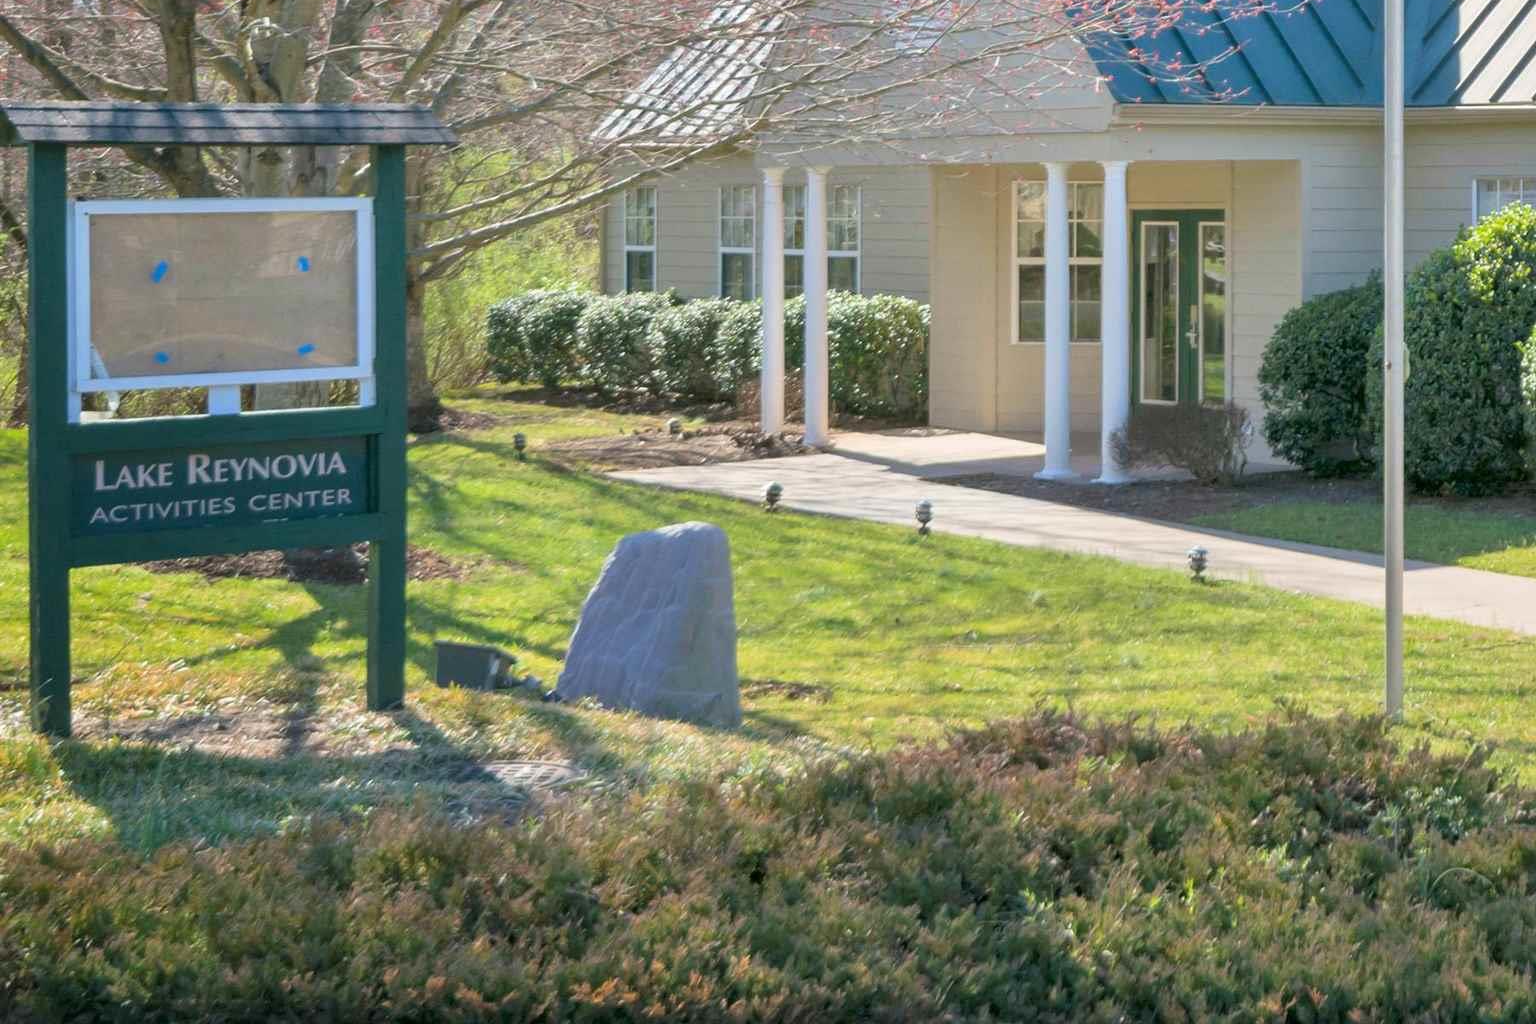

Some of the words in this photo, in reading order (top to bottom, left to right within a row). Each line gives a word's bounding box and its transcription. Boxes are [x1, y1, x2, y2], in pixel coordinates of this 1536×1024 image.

[95, 460, 173, 491] LAKE
[187, 451, 347, 485] REYNOVIA
[89, 497, 236, 524] ACTIVITIES
[248, 488, 352, 511] CENTER
